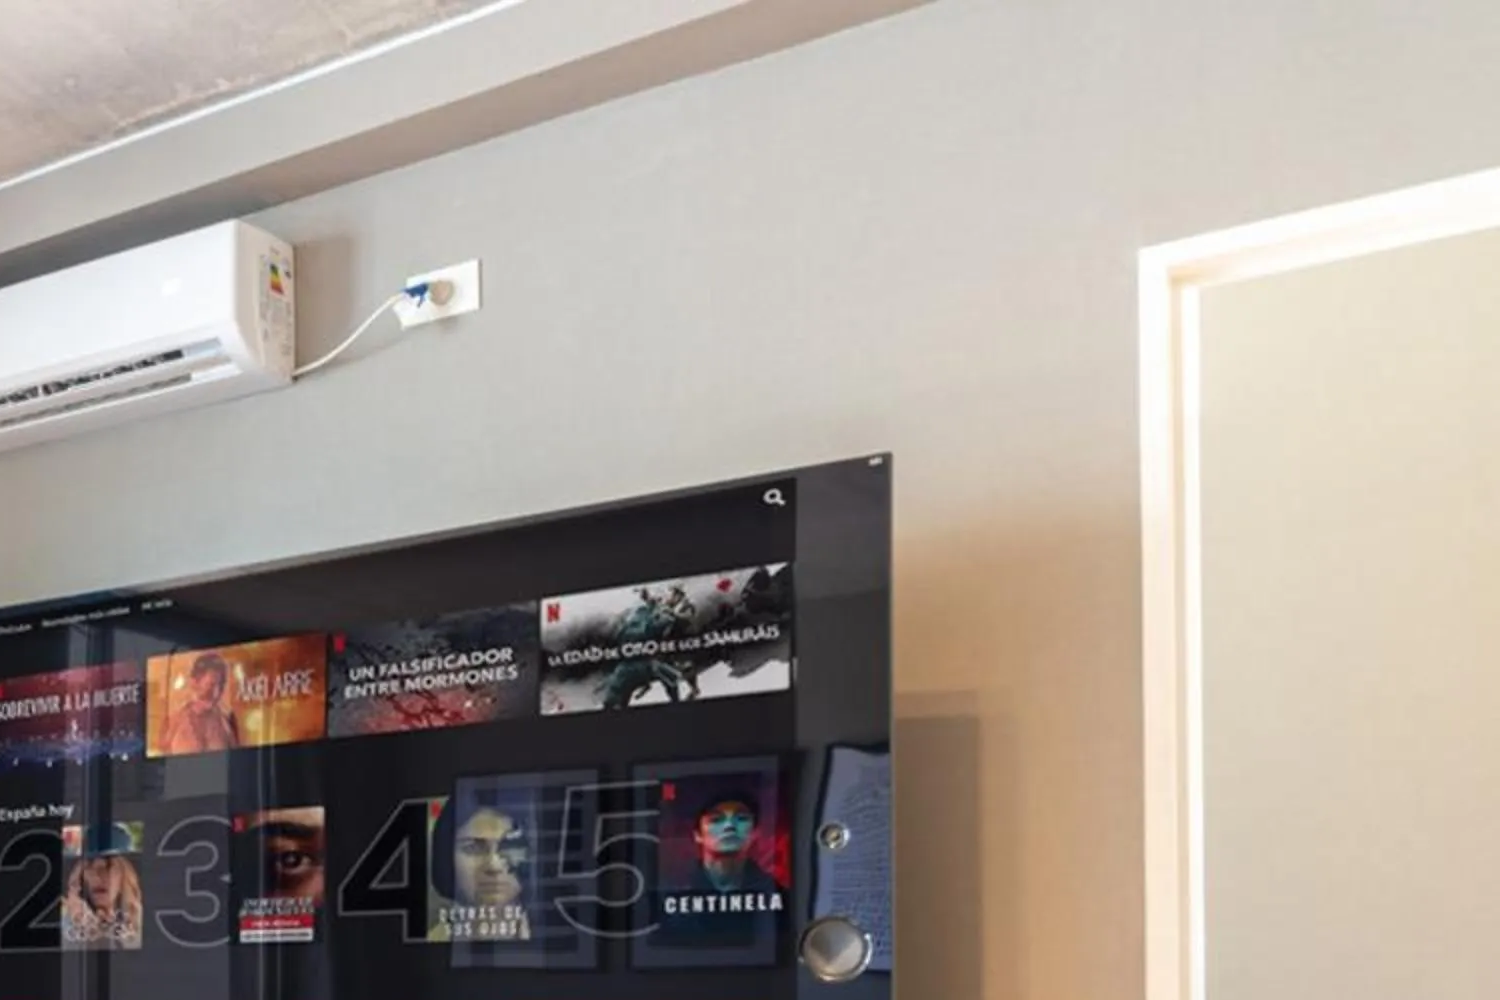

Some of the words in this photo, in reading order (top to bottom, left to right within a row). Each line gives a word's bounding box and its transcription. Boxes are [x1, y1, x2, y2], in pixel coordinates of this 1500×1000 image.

[350, 666, 375, 682] UN
[379, 647, 513, 675] FALSIFICADOR
[548, 655, 563, 667] LA
[563, 646, 603, 664] EDAD
[660, 639, 676, 652] DE
[63, 693, 73, 711] A
[74, 691, 90, 710] LA
[93, 683, 140, 708] MUERTE
[344, 680, 399, 699] ENTRE
[404, 664, 518, 693] MORMONES
[48, 803, 75, 819] hoy
[338, 798, 428, 943] 4
[554, 780, 660, 937] 5
[155, 815, 231, 947] 3
[664, 893, 784, 914] CENTINELA
